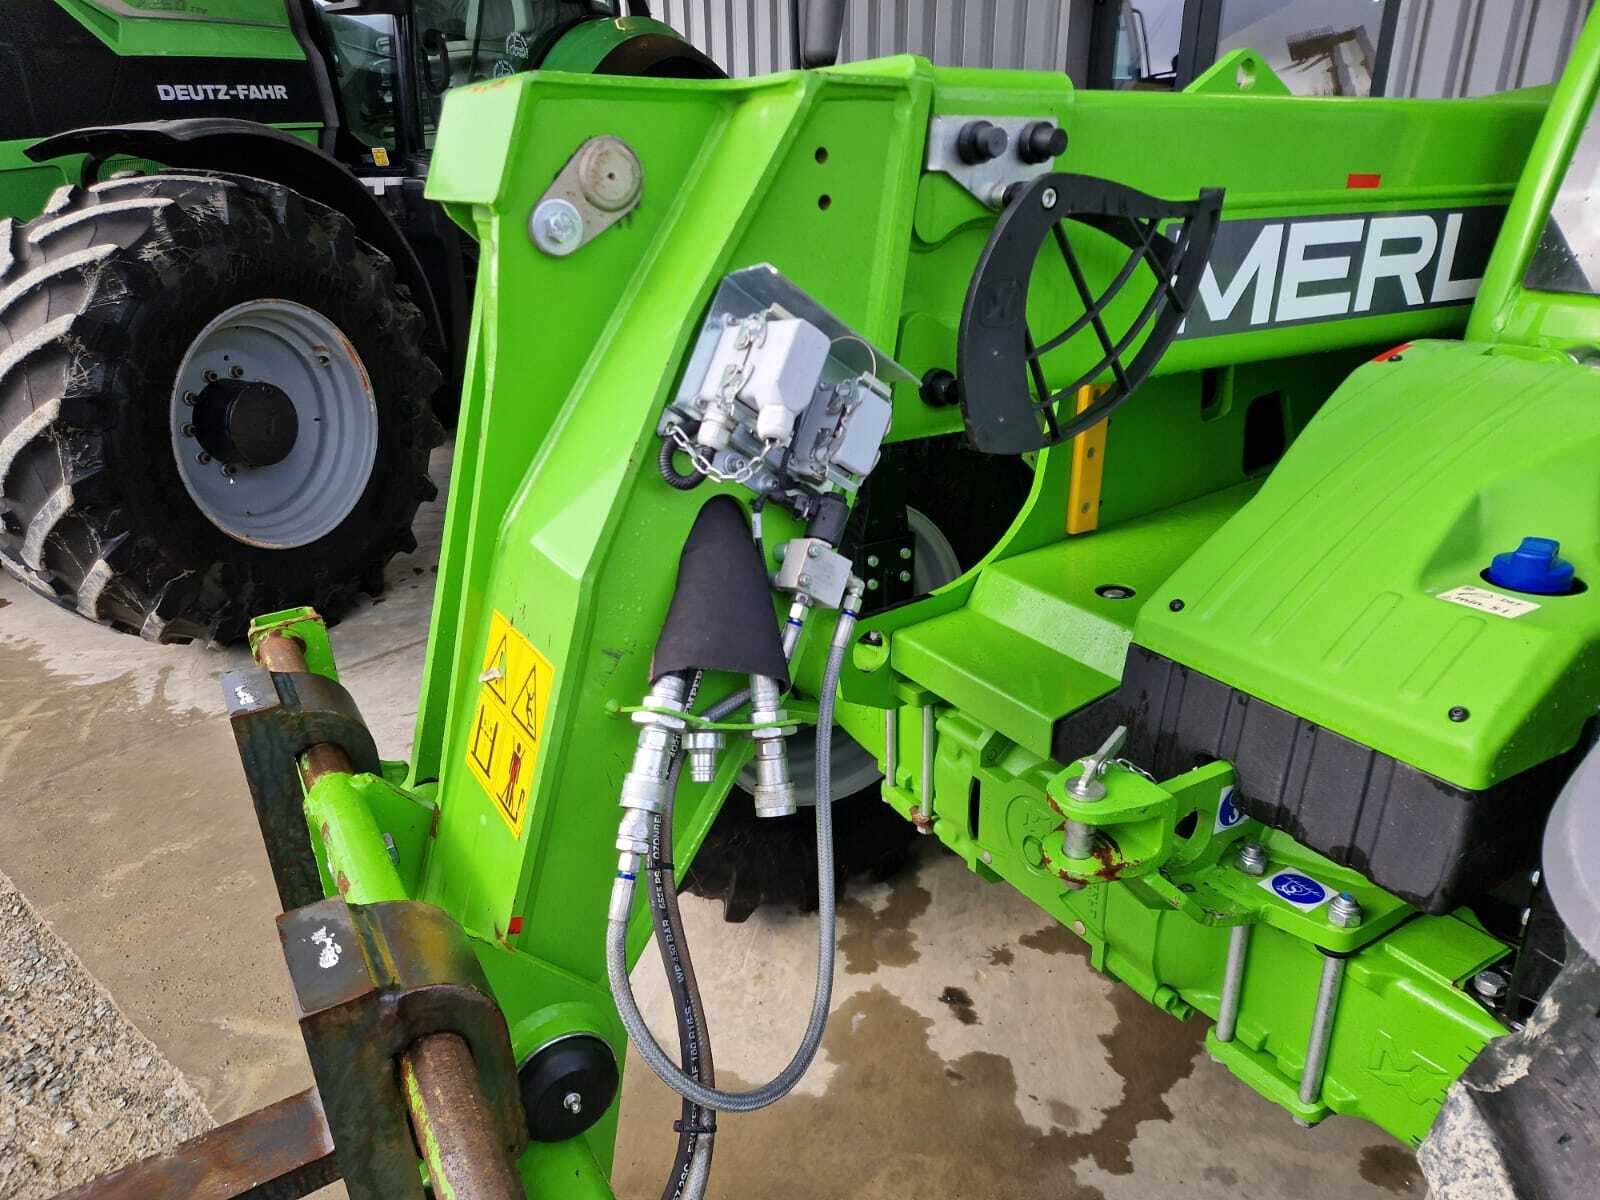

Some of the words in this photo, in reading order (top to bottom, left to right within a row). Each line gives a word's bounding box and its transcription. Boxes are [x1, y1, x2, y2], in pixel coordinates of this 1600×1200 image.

[157, 84, 288, 101] DEUTZ-FAHR
[652, 814, 661, 859] OZONRE
[663, 919, 674, 942] BAR
